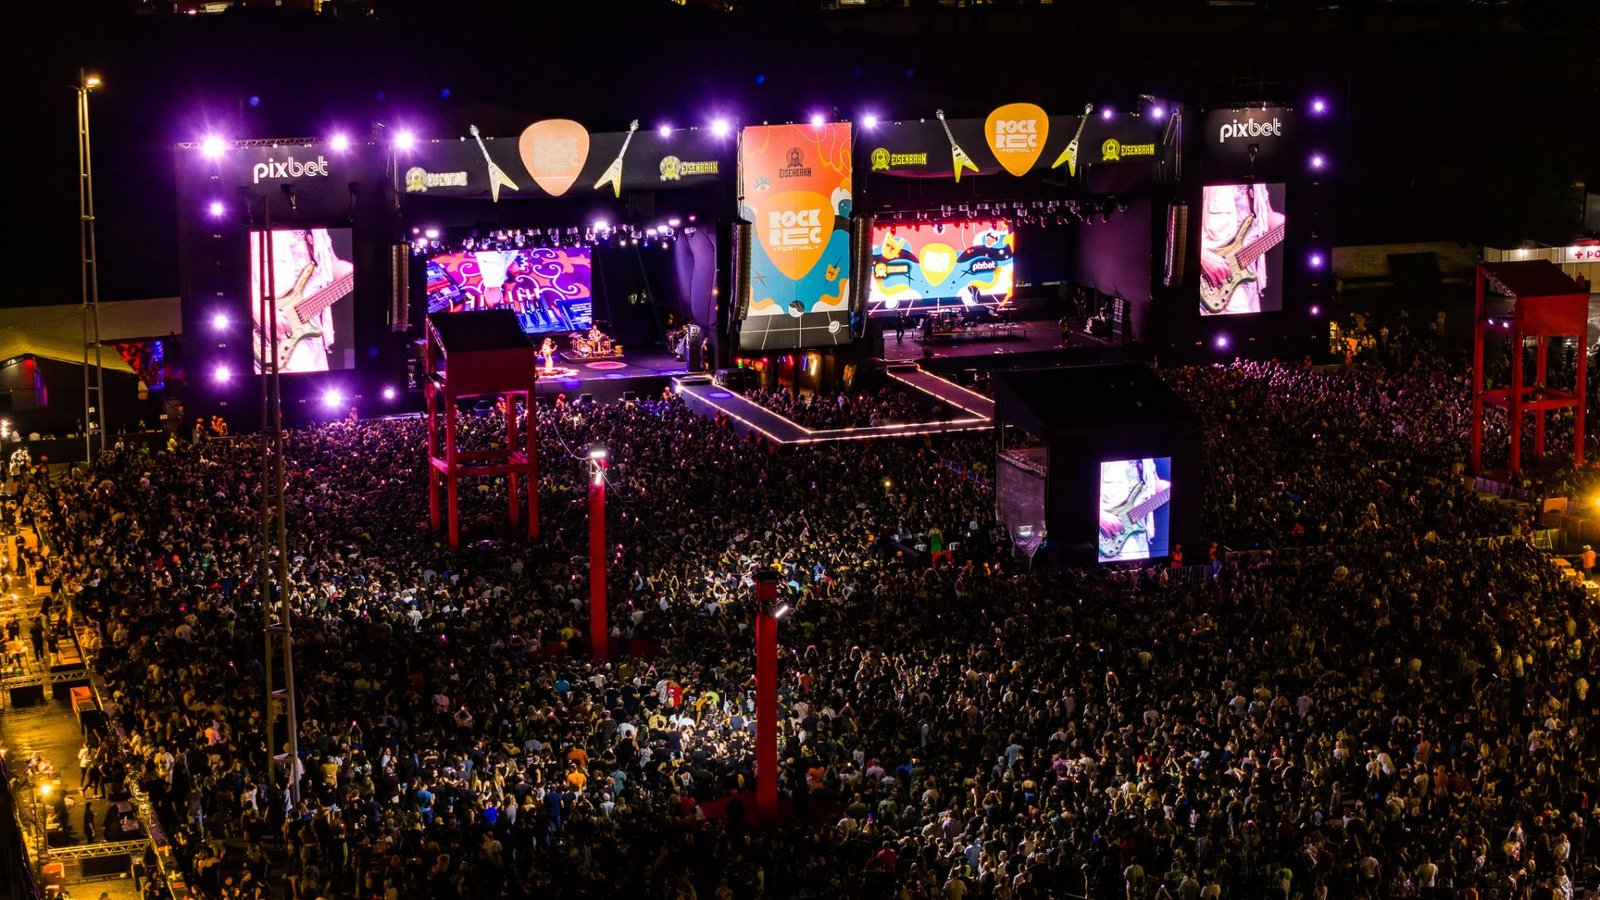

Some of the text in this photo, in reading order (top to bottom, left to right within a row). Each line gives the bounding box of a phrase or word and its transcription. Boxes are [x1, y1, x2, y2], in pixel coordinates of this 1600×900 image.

[995, 119, 1038, 134] ROCK
[1220, 117, 1282, 143] pixbet
[995, 134, 1038, 148] REC
[1120, 143, 1155, 157] EISENBAHN
[891, 153, 927, 166] EISENBAHN
[253, 155, 328, 184] pixbet
[680, 160, 719, 176] EISENBAHN
[779, 167, 812, 178] EISENBAHN
[768, 209, 822, 228] ROCK
[768, 227, 822, 246] REC
[776, 244, 815, 252] FESTIVAL
